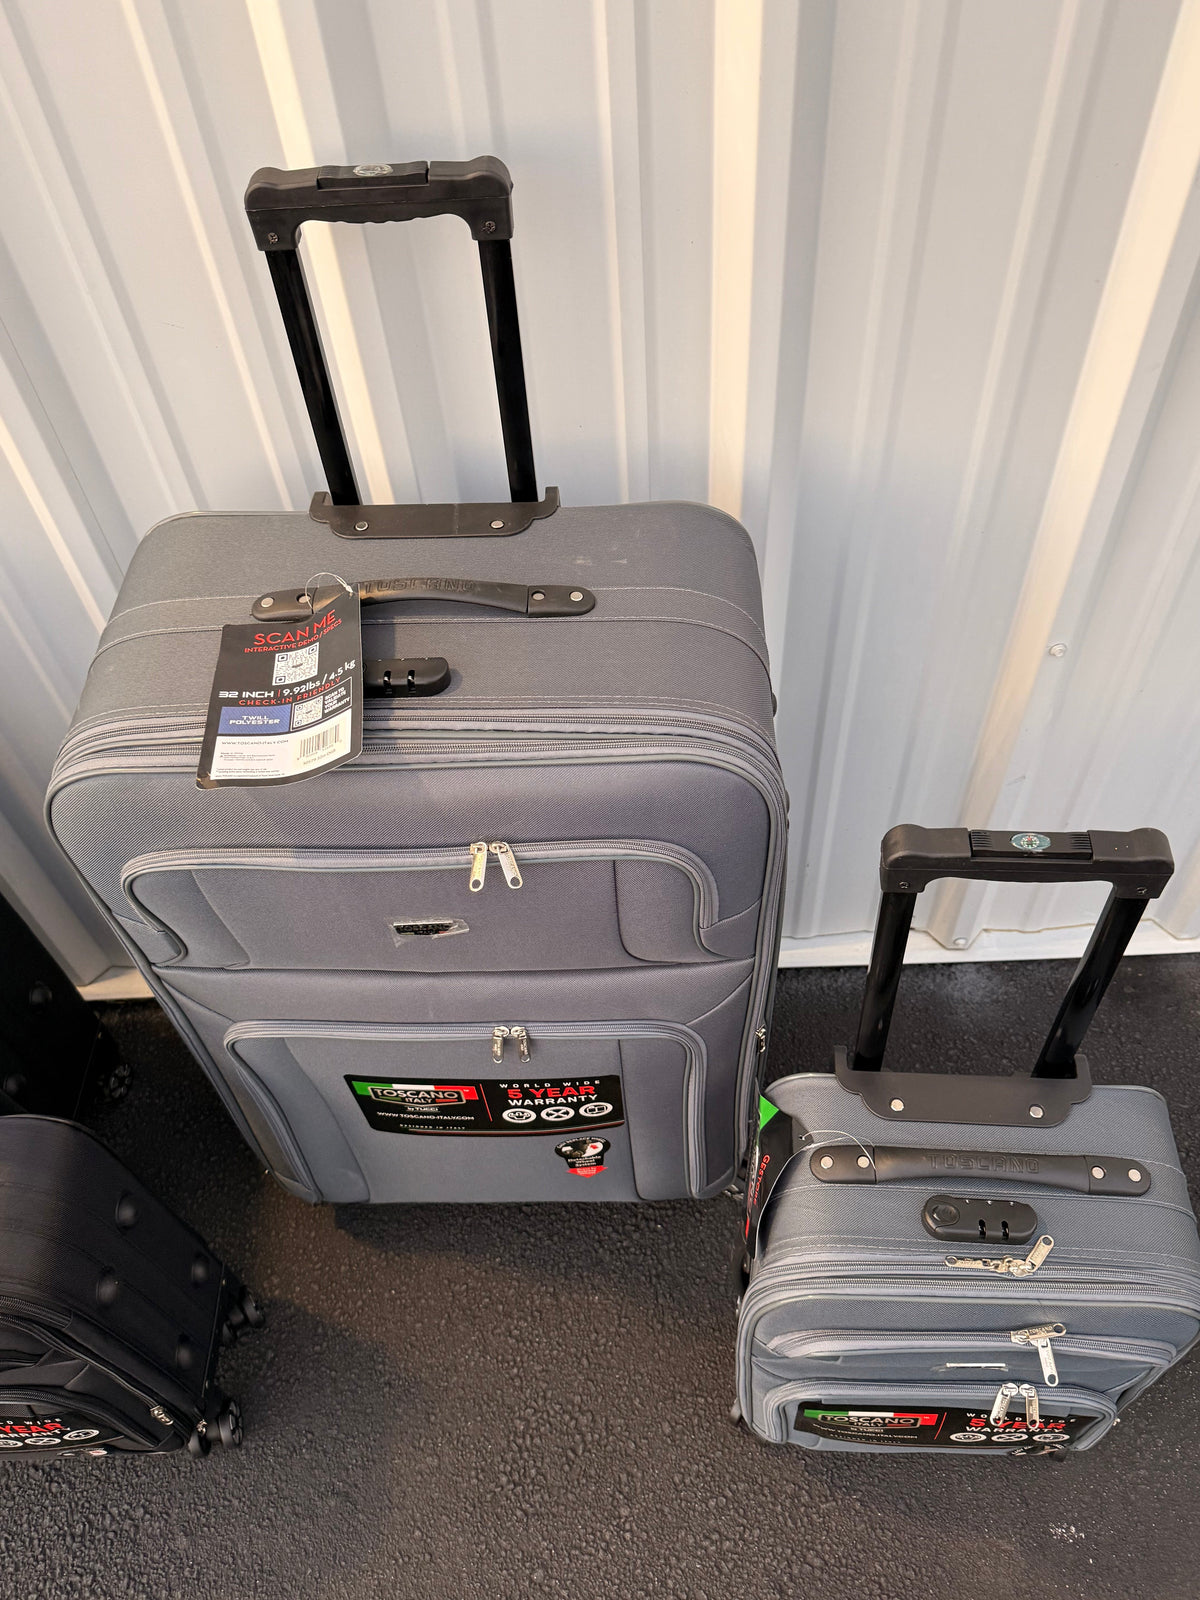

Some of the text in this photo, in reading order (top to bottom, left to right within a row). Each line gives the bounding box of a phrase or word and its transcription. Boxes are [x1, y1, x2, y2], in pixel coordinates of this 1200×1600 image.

[253, 609, 336, 646] SCAN ME
[244, 643, 297, 653] INTERACTIVE
[242, 690, 274, 698] INCH
[344, 659, 356, 671] kg
[238, 677, 341, 706] CHECK-IN FRIENDLY
[373, 1088, 458, 1099] TOSCANO
[507, 1086, 595, 1099] 5 YEAR
[508, 1094, 598, 1106] WARRANTY
[926, 1152, 1040, 1174] TOSCANO
[824, 1416, 915, 1424] TOSCANO
[969, 1418, 986, 1427] 5
